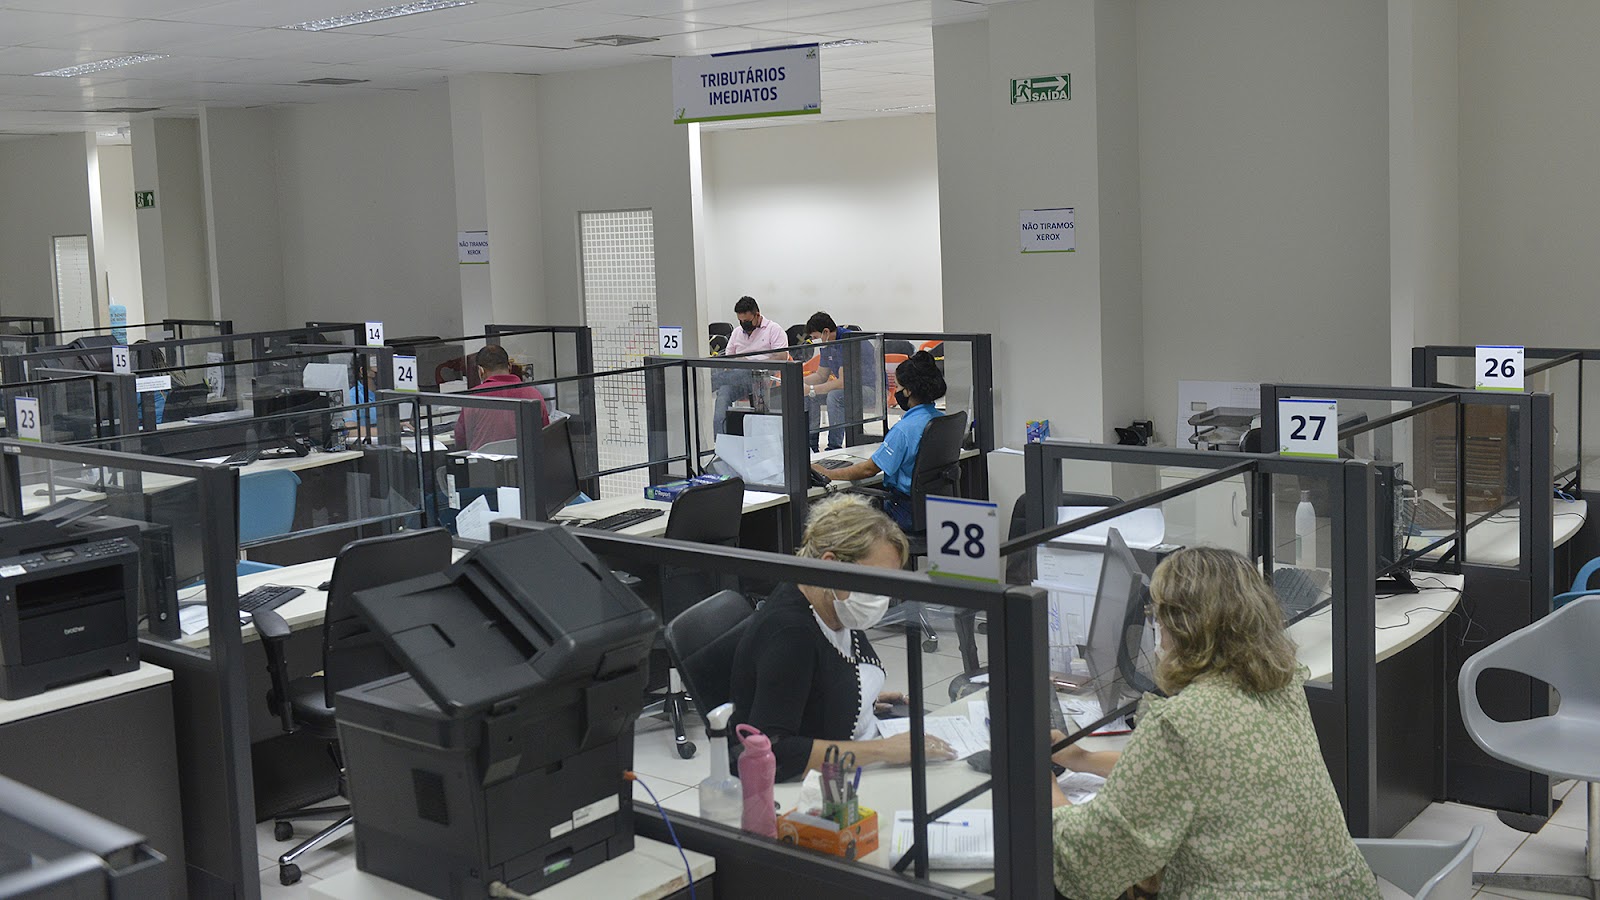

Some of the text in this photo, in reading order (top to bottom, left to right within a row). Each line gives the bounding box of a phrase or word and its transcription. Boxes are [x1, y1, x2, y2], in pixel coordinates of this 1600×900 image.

[700, 66, 786, 88] TRIBUTÁRIOS
[709, 86, 778, 106] IMEDIATOS
[1032, 89, 1067, 101] SAÍDA
[1022, 221, 1074, 230] NÃO TIRAMOS
[1036, 233, 1060, 241] XEROX
[369, 328, 380, 340] 14
[663, 335, 678, 349] 25
[116, 354, 127, 367] 15
[1484, 357, 1516, 378] 26
[398, 366, 413, 382] 24
[21, 409, 35, 429] 23
[1290, 415, 1327, 441] 27
[940, 520, 985, 559] 28
